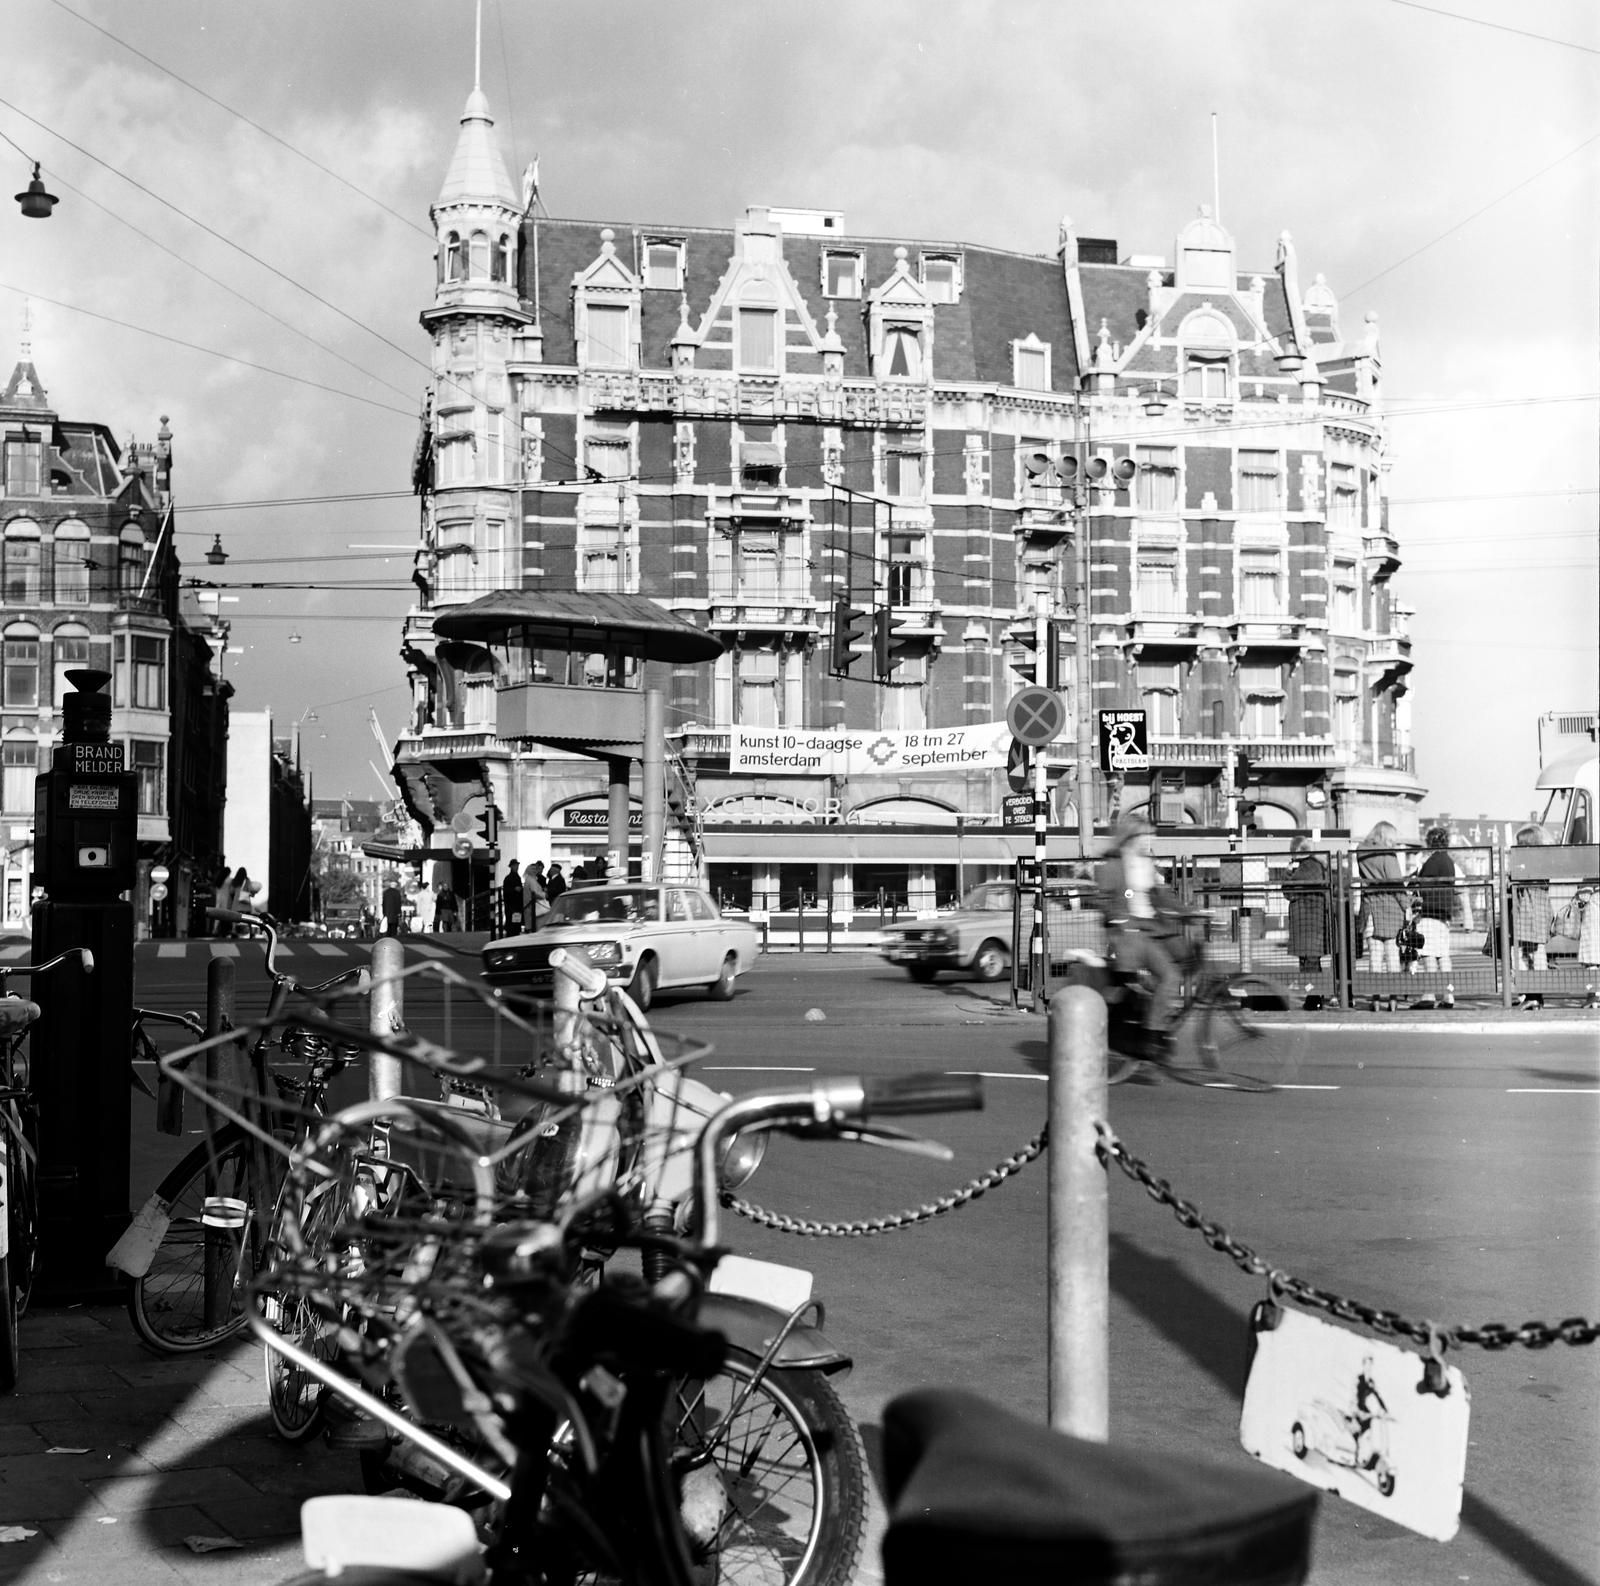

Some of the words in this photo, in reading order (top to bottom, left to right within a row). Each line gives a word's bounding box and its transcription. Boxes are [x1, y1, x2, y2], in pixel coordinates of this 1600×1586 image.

[1102, 713, 1115, 724] bij
[1116, 713, 1144, 722] HOEST
[740, 734, 779, 749] kunst
[783, 736, 862, 753] 10-daagse
[905, 735, 918, 748] 18
[923, 735, 943, 747] tm
[947, 733, 965, 746] 27
[75, 745, 123, 759] BRAND
[902, 748, 988, 766] september
[75, 760, 122, 773] MELDER
[740, 753, 821, 767] amsterdam
[1005, 796, 1035, 806] VERBODEN
[1012, 806, 1026, 815] OVER
[569, 811, 643, 825] Restant
[1005, 816, 1012, 824] TE
[1014, 814, 1034, 823] STEKEN
